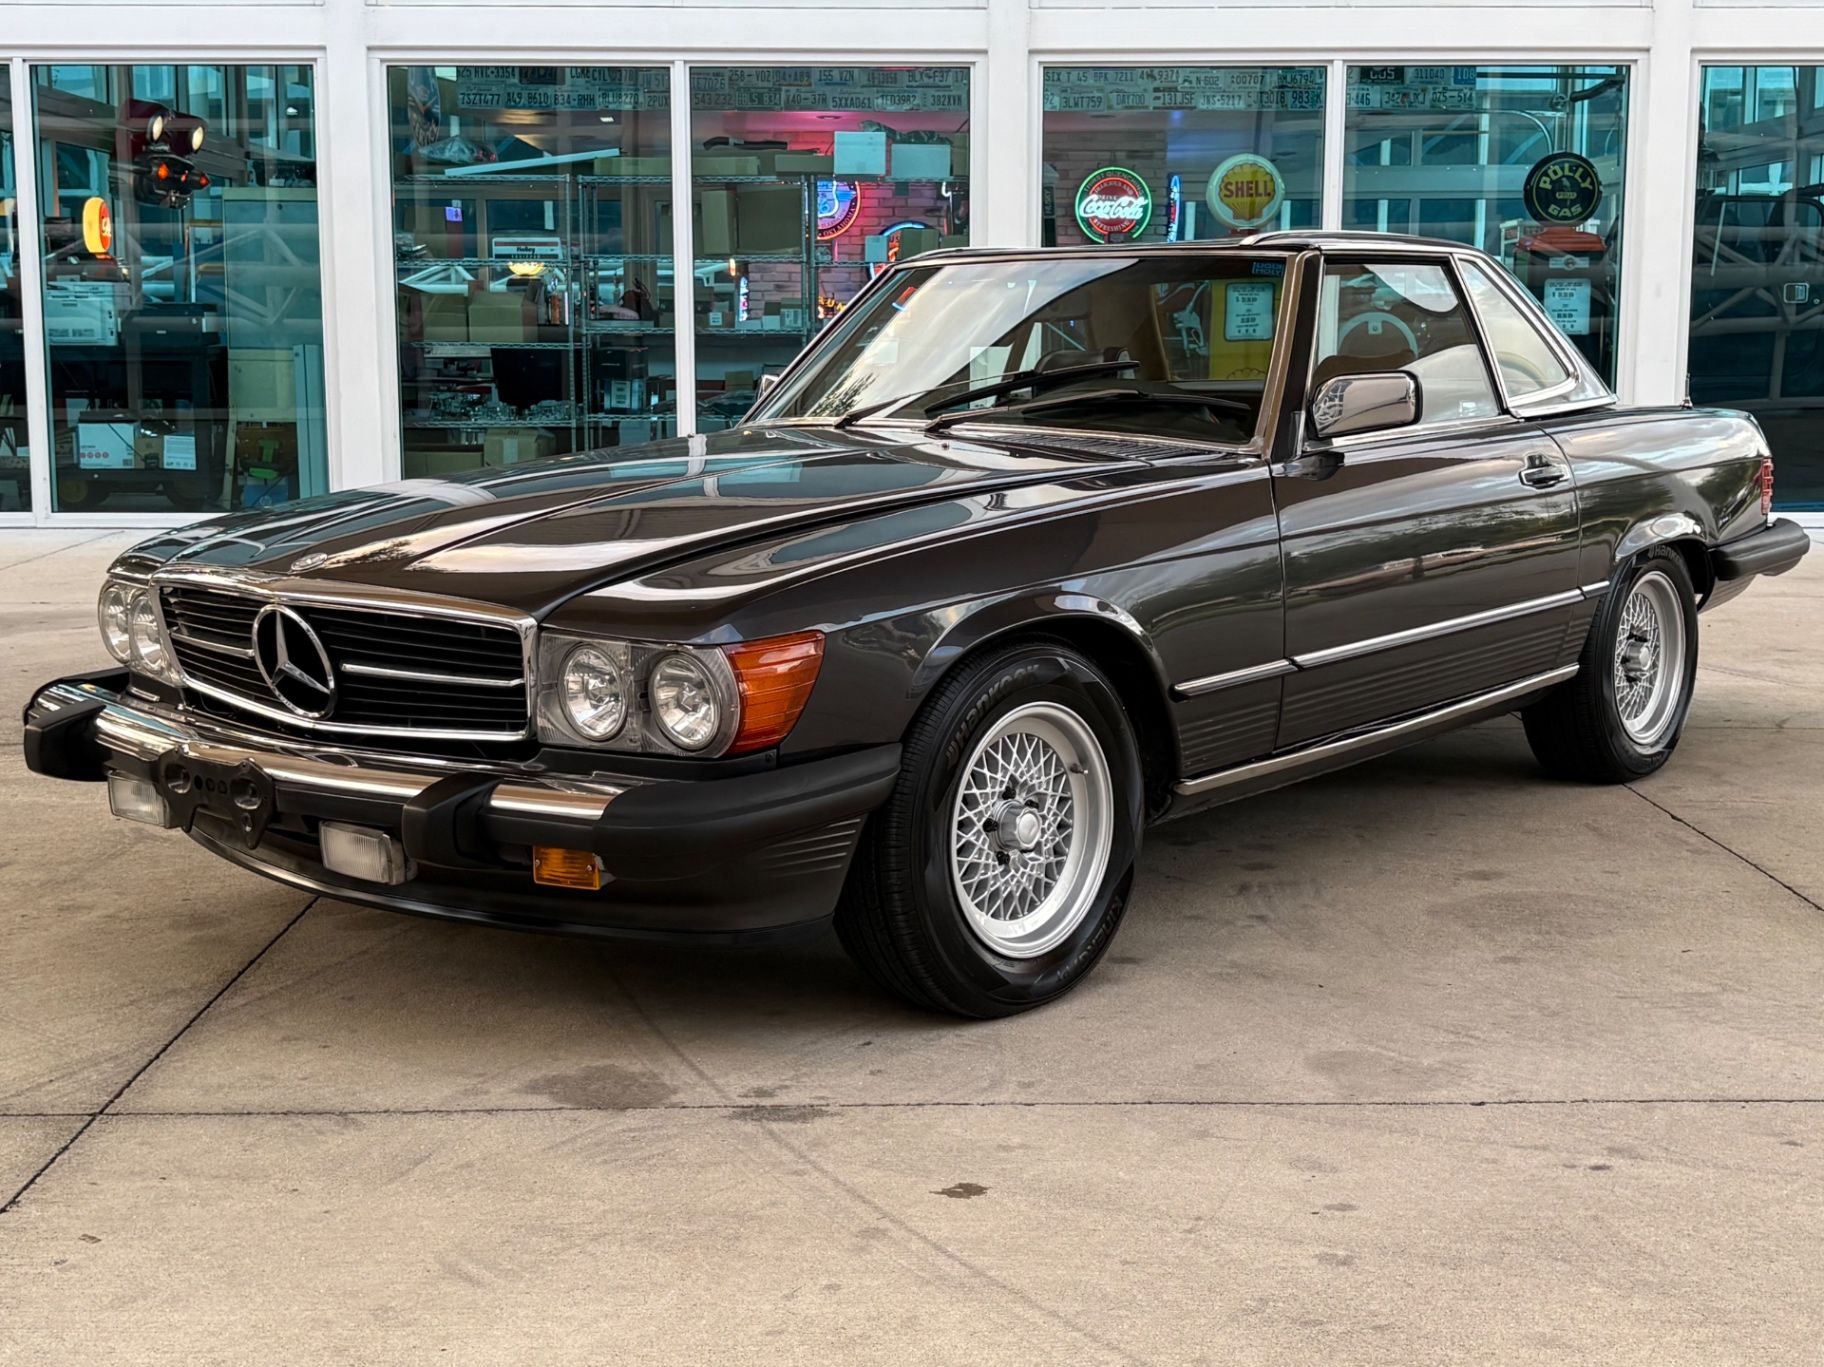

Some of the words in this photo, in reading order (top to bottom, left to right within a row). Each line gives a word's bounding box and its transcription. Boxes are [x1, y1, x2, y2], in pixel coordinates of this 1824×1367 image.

[1538, 162, 1593, 190] POLLY
[1222, 180, 1272, 198] SHELL
[1547, 203, 1583, 217] GAS
